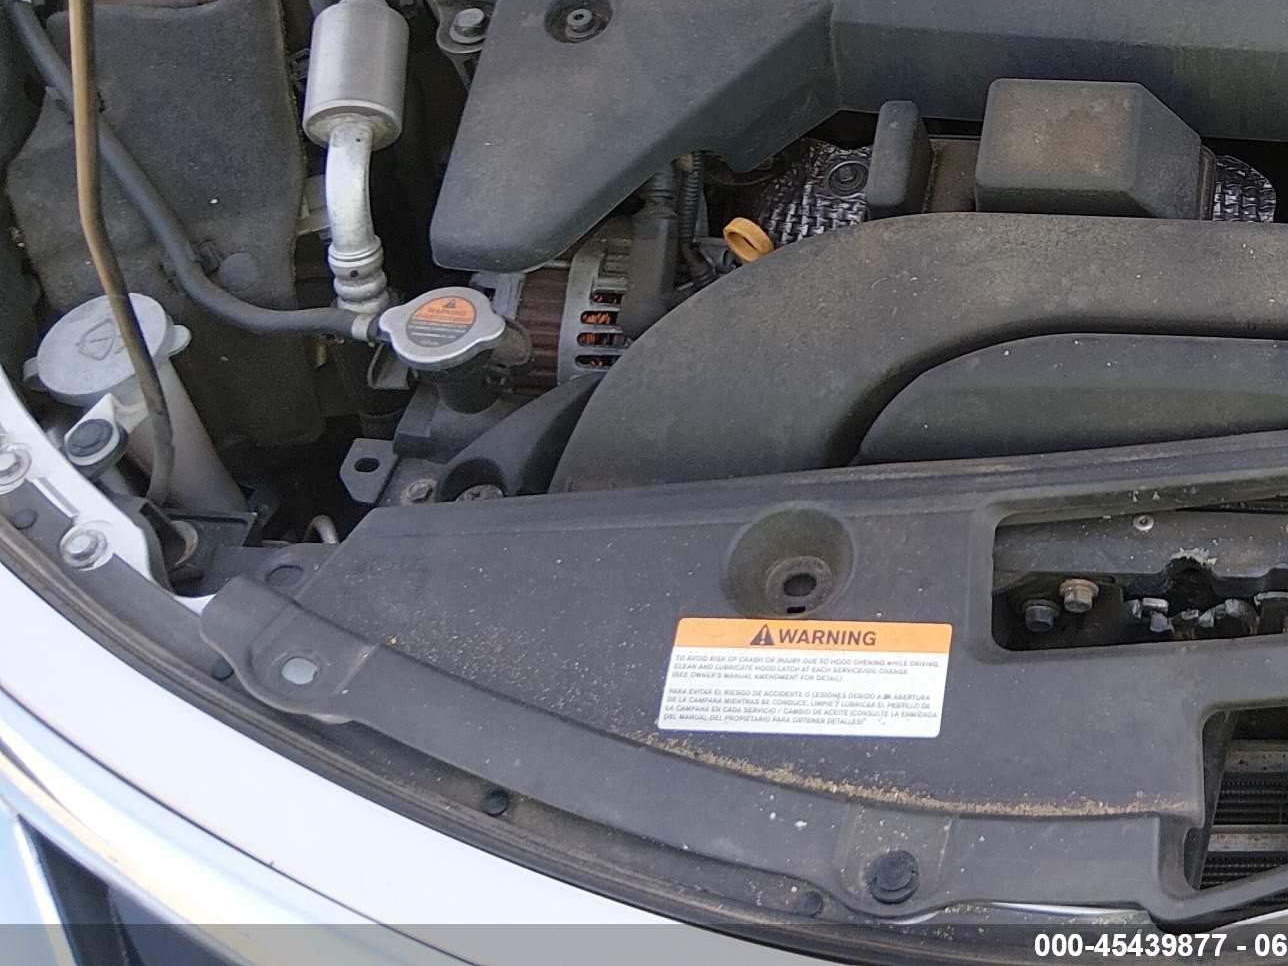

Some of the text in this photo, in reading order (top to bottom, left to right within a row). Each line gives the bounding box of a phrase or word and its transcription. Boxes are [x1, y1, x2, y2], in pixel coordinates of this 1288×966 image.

[779, 628, 877, 646] WARNING
[673, 662, 697, 670] CLEAN
[755, 664, 777, 672] HOOD
[831, 658, 852, 666] HOOD
[754, 673, 799, 681] AMENDMENT
[763, 690, 803, 698] ACCIDENTE
[812, 691, 847, 699] LESIONES
[848, 692, 876, 700] DEBIDO
[893, 694, 931, 702] ABERTURA
[744, 706, 777, 714] SERVICIO
[823, 708, 849, 716] ACEITE
[887, 702, 920, 710] PESTILLO
[724, 714, 771, 723] PROPIETARIO
[792, 716, 825, 724] OBTENER
